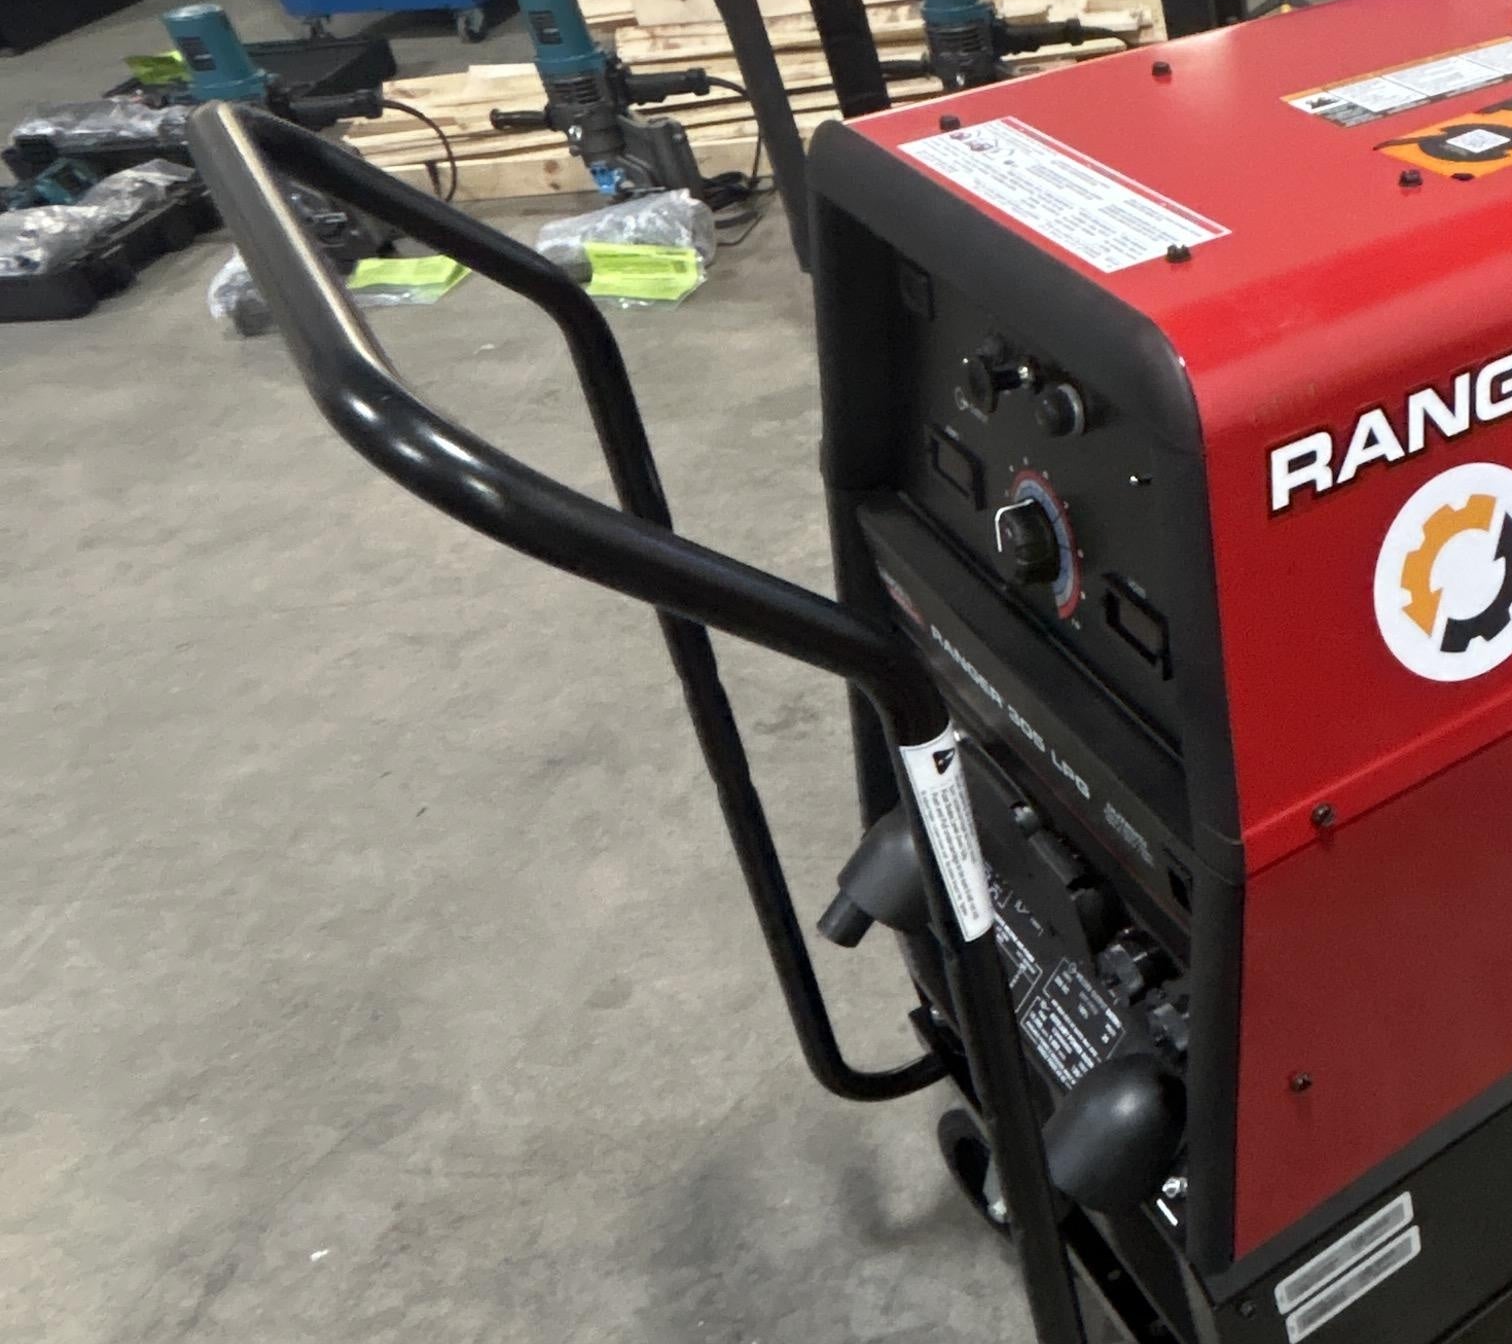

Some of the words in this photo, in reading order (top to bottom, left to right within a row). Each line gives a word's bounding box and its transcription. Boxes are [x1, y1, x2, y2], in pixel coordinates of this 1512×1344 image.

[930, 624, 1004, 709] RANGER
[1006, 704, 1046, 753] 305
[1050, 748, 1091, 800] LPG
